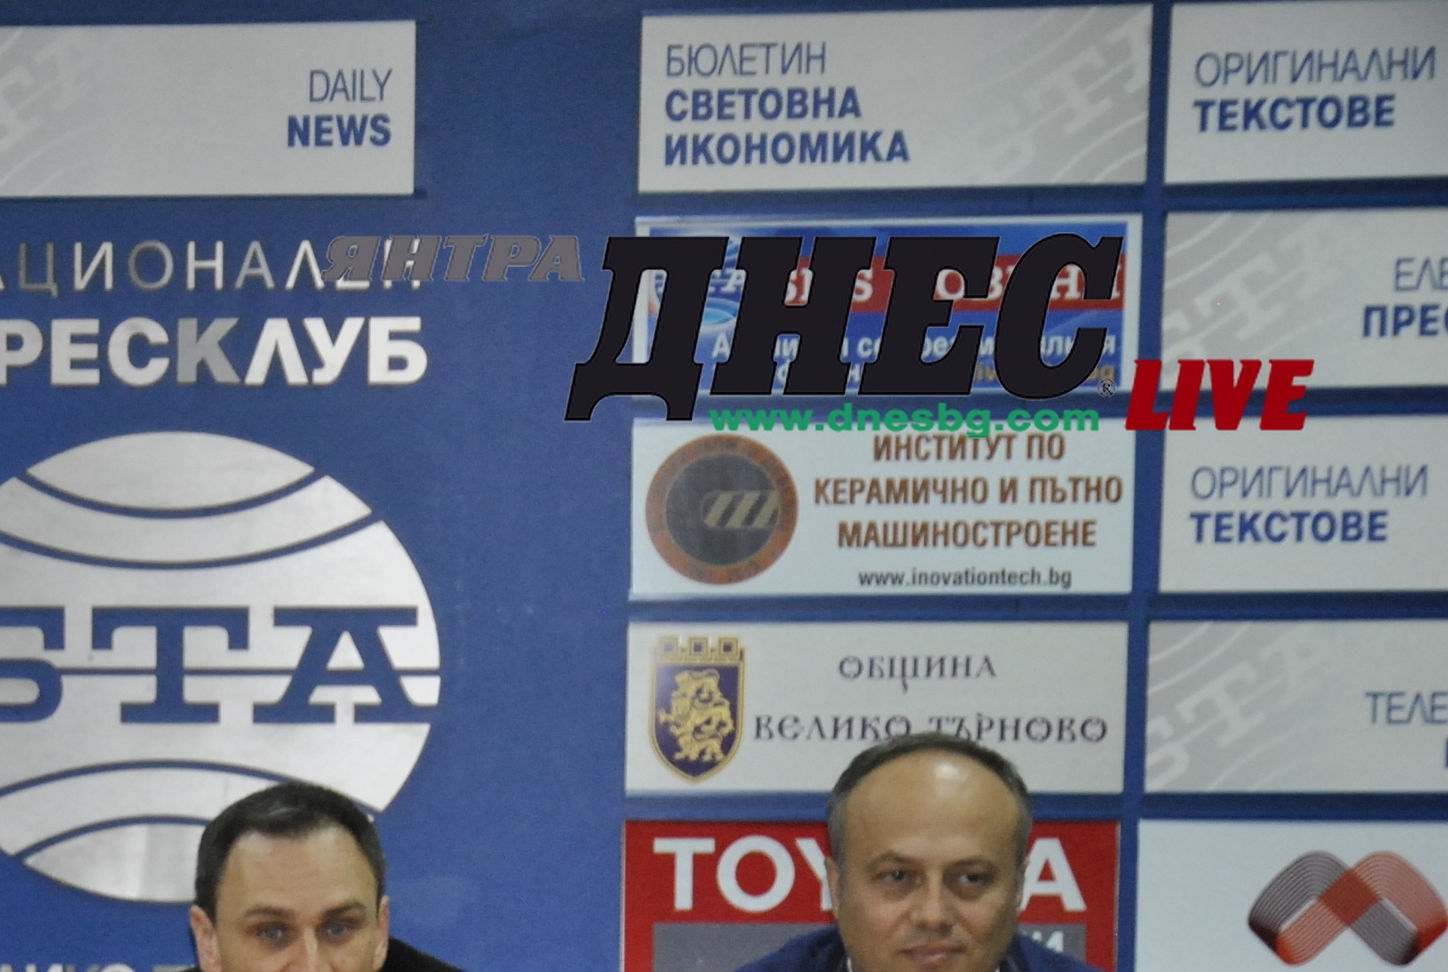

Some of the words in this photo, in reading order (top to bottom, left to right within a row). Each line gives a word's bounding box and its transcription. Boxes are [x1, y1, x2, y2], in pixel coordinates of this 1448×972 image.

[665, 42, 827, 77] БЮЛЕТИН
[1195, 46, 1436, 87] ОРИГИНАЛНИ
[309, 69, 393, 102] DAILY
[664, 86, 862, 122] СВЕТОВНА
[1192, 93, 1395, 132] ТЕКСТОВЕ
[287, 114, 391, 147] NEWS
[664, 130, 910, 166] ИКОНОМИКА
[1362, 303, 1448, 338] ПРЕ
[873, 434, 1018, 461] ИНСТИТУТ
[1026, 433, 1066, 461] ПО
[814, 477, 988, 505] КЕРАМИЧНО
[998, 477, 1018, 504] И
[1028, 476, 1123, 503] ПЪТНО
[1190, 465, 1428, 499] ОРИГИНАЛНИ
[837, 520, 1097, 549] МАШИНОСТРОЕНЕ
[1189, 510, 1389, 544] ТЕКСТОВЕ
[858, 567, 1073, 588] www.inovationtech.bg
[838, 655, 997, 694] ОБЩИНА
[753, 715, 912, 741] ВЕЛИКО
[928, 713, 1108, 743] ТЪРНОВО
